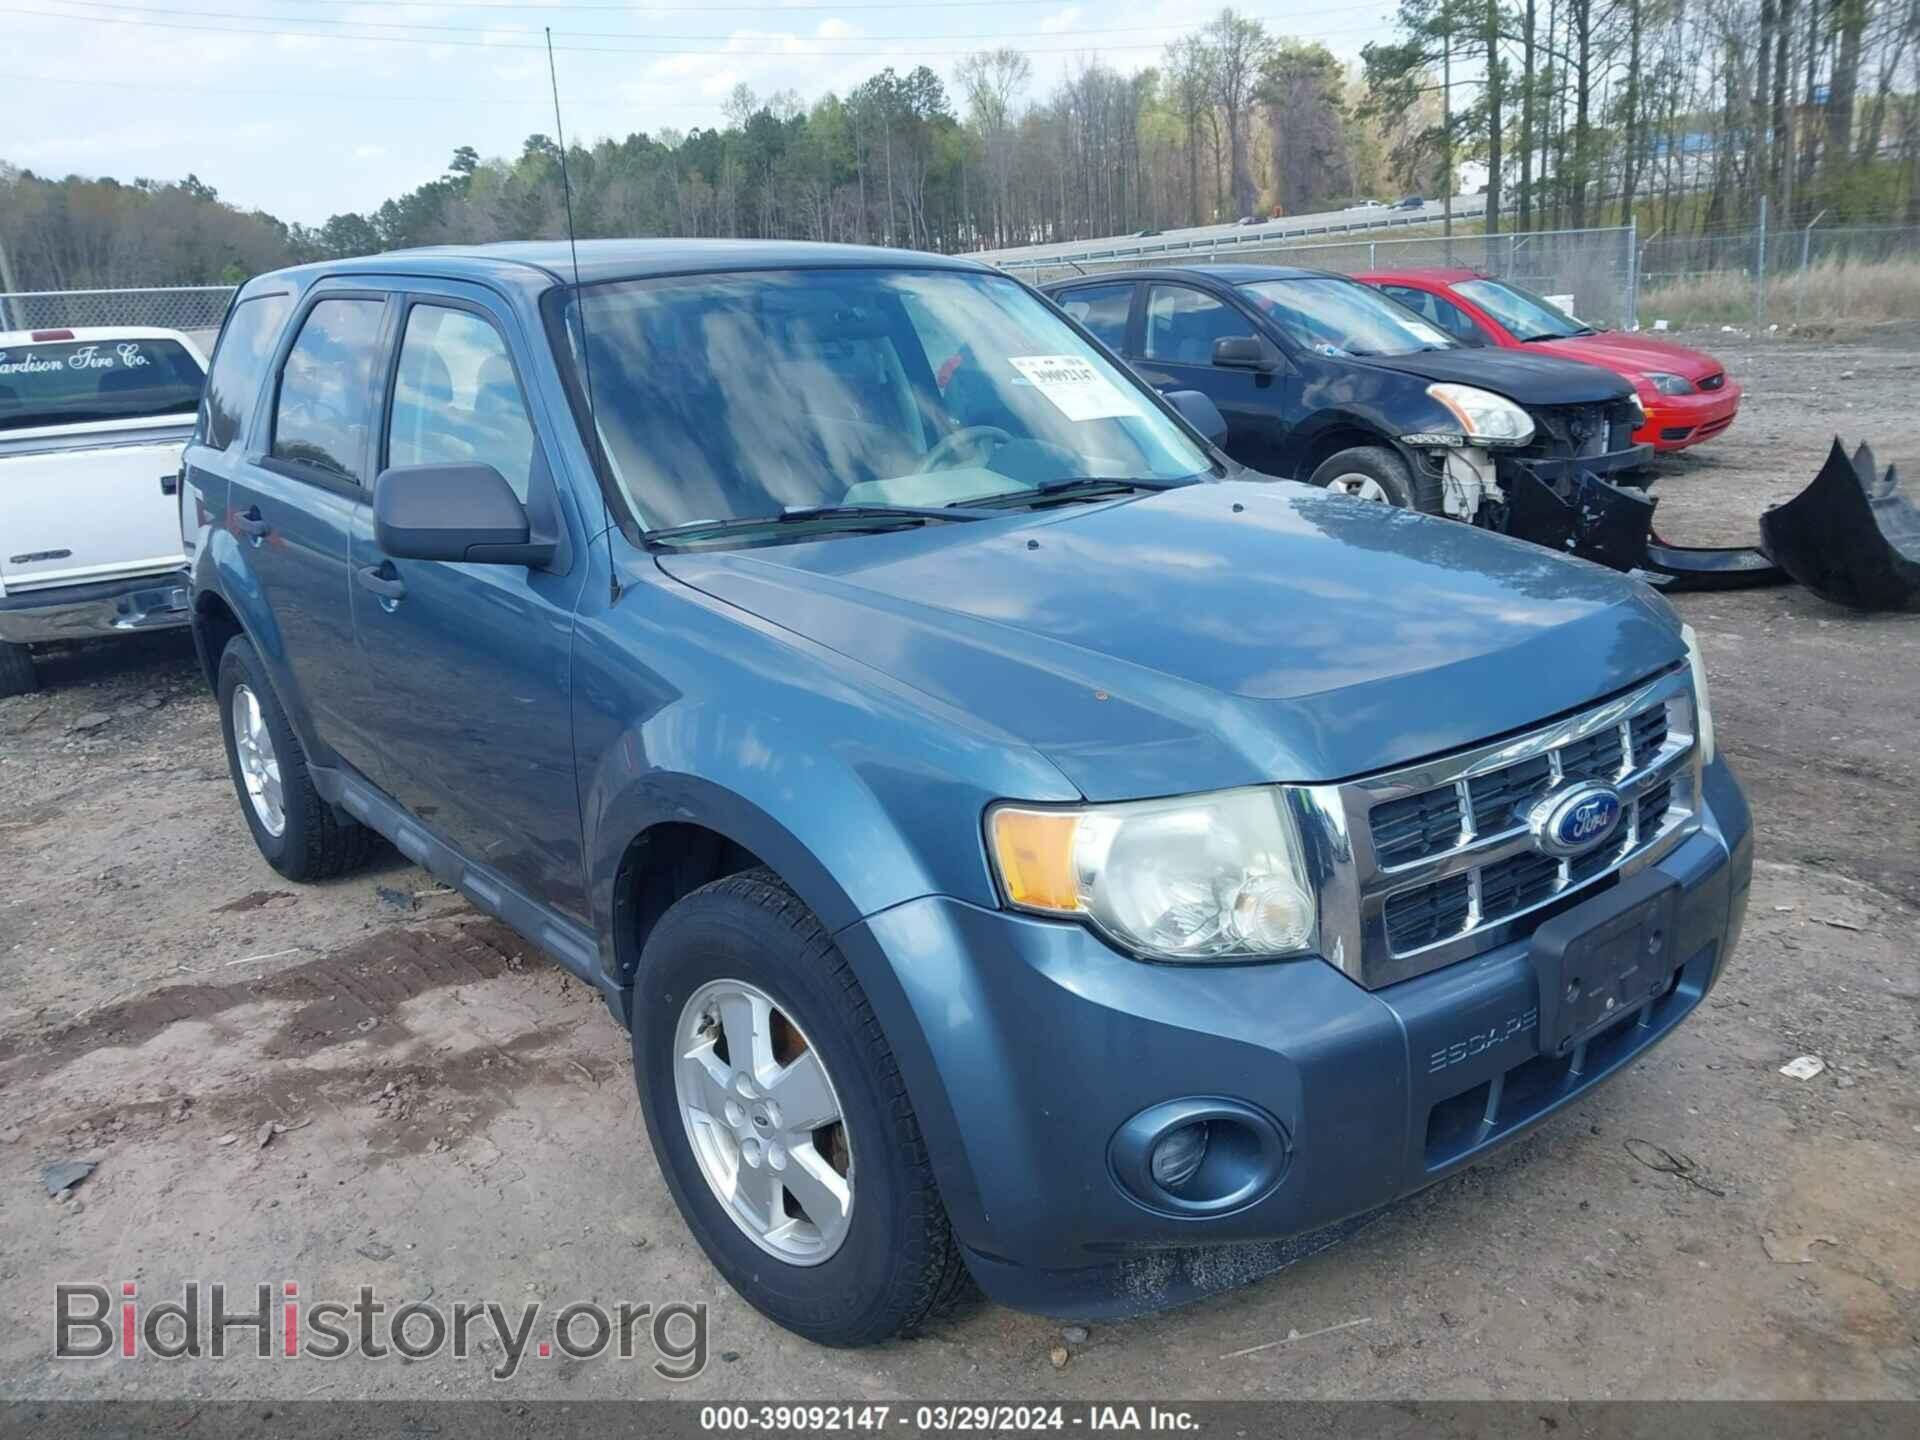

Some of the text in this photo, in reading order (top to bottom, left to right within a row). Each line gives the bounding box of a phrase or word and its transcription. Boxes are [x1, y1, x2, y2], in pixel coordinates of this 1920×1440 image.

[68, 345, 115, 370] Tire
[116, 343, 151, 368] Co.
[1573, 800, 1610, 838] Ford
[1428, 1006, 1537, 1073] ESCAPE
